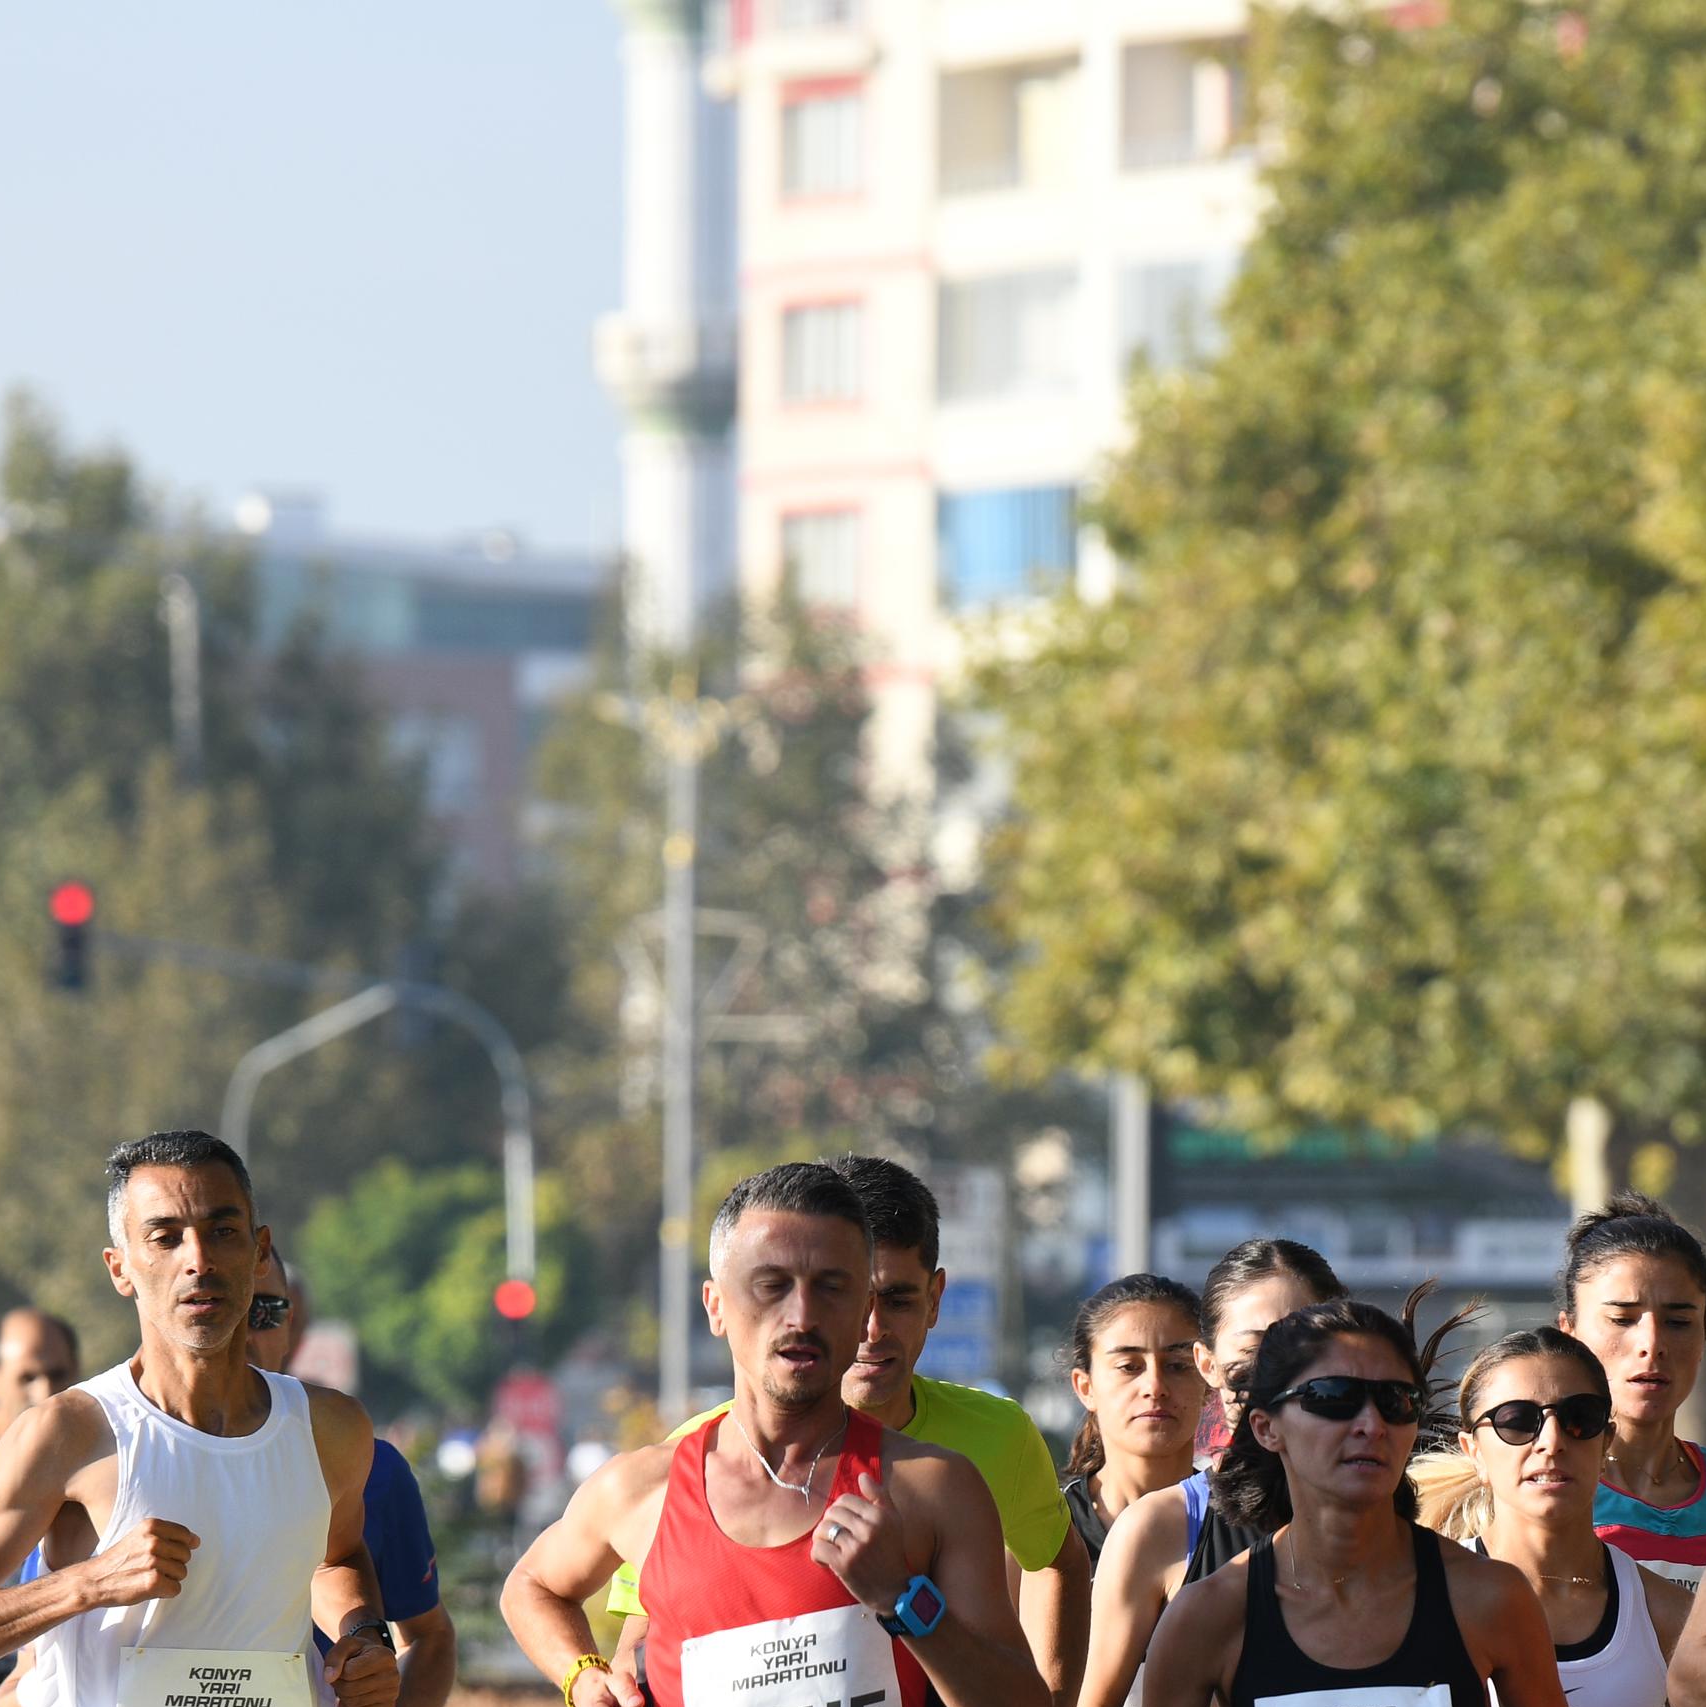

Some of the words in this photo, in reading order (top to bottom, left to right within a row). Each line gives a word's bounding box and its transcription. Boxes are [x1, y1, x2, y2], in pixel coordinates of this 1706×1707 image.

[750, 1633, 817, 1657] KONYA
[763, 1651, 808, 1670] YARI
[189, 1667, 252, 1681] KONYA
[732, 1658, 847, 1692] MARATONU
[199, 1682, 241, 1695] YARI
